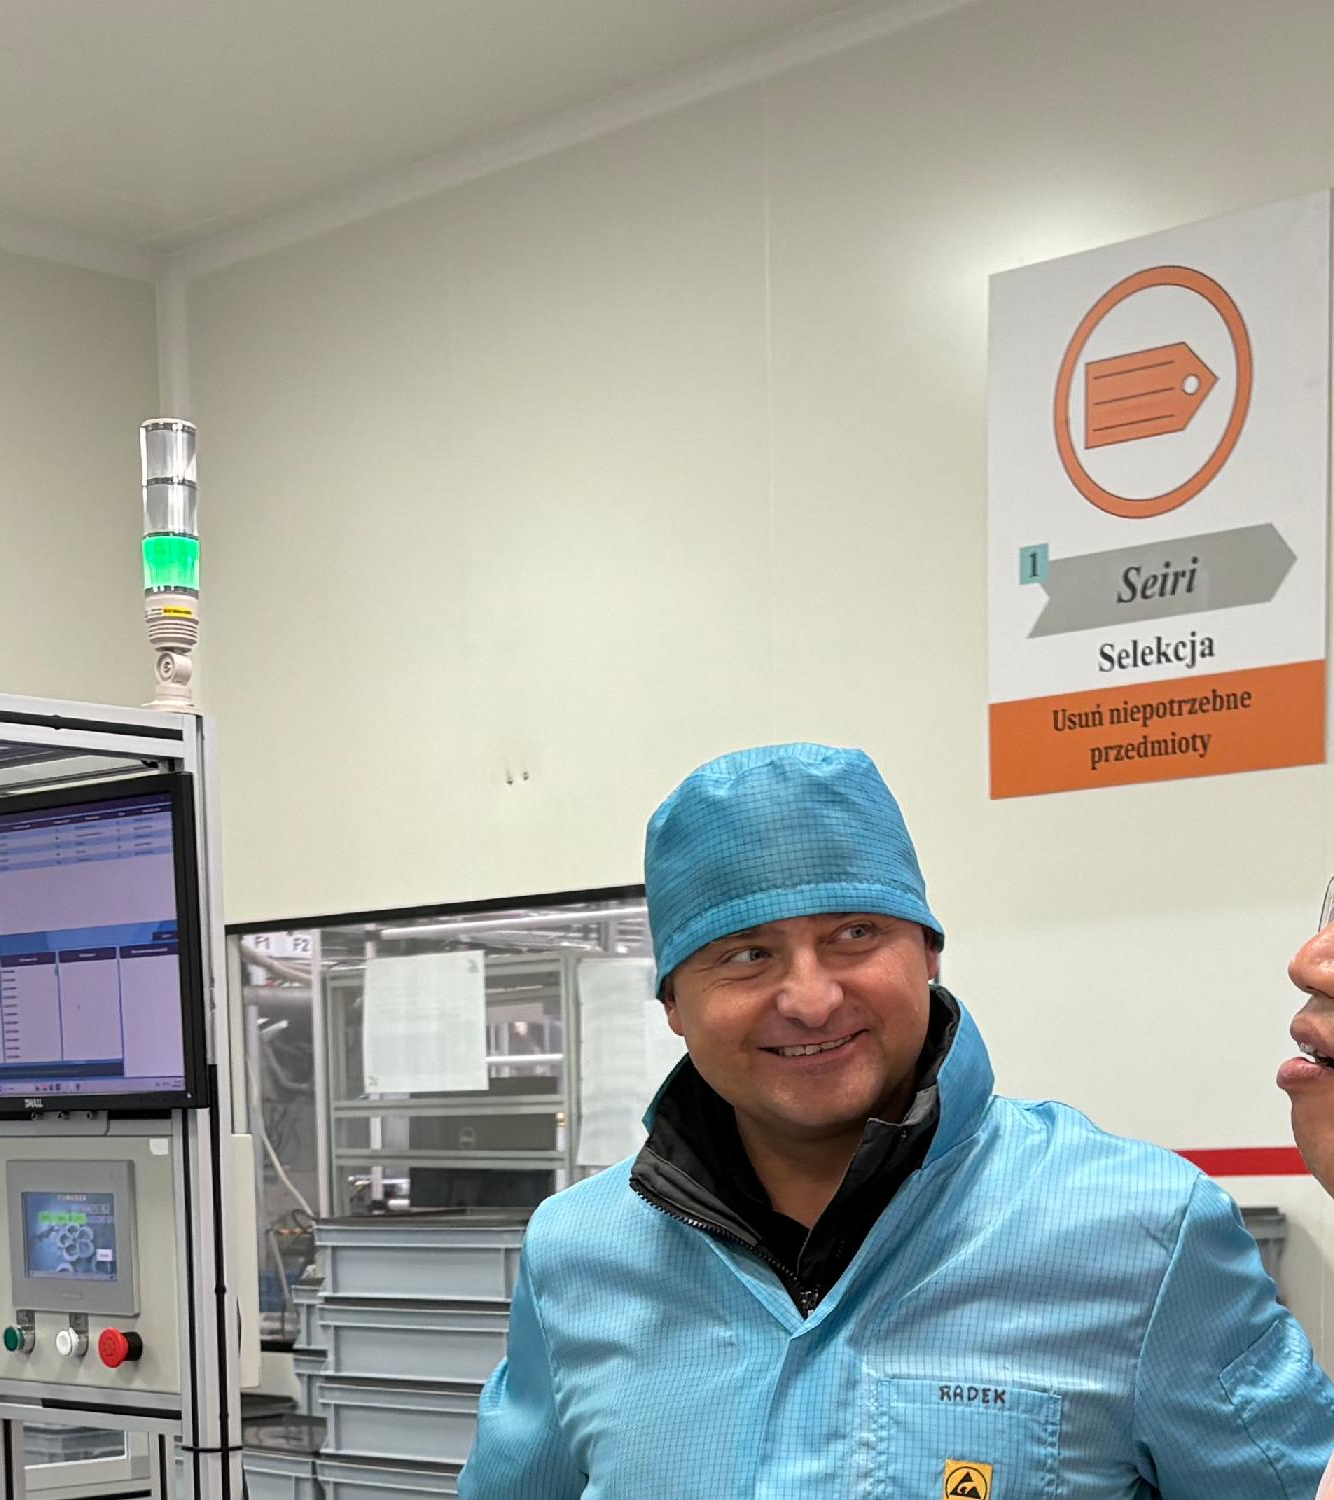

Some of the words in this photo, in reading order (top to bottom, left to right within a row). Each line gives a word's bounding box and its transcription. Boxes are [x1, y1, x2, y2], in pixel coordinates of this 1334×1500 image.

[1028, 552, 1039, 578] 1
[1116, 556, 1200, 603] Seiri
[1098, 631, 1215, 673] Selekcja
[1052, 703, 1104, 732] Usuń
[1109, 689, 1253, 727] niepotrzebne
[1090, 732, 1212, 771] przedmioty
[938, 1384, 1007, 1405] RADEK
